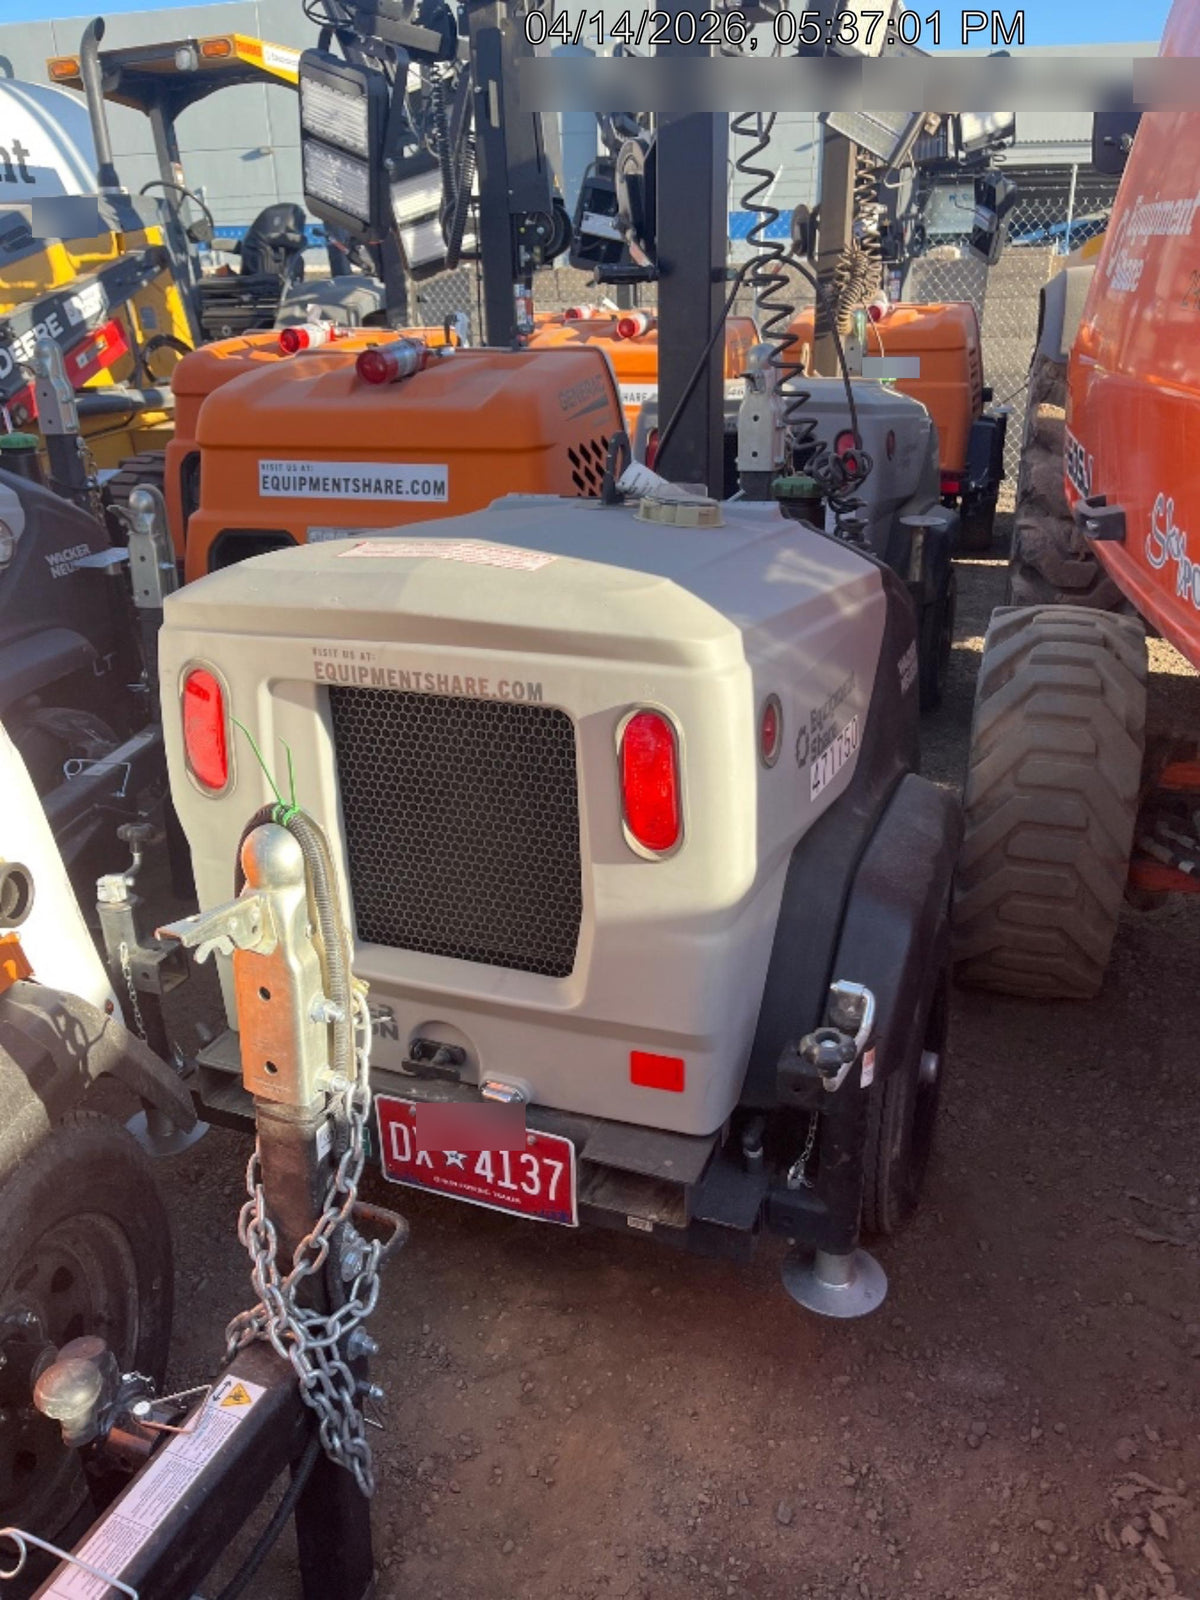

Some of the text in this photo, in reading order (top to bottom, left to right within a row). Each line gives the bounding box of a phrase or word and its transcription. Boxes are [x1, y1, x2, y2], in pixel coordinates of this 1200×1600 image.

[261, 463, 283, 472] VISIT
[287, 464, 298, 472] US
[261, 475, 446, 497] EQUIPMENTSHARE.COM
[312, 647, 338, 658] VISIT
[342, 650, 355, 660] US
[313, 661, 544, 701] EQUIPMENTSHARE.COM
[812, 715, 859, 792] 471750
[474, 1150, 564, 1201] 4137
